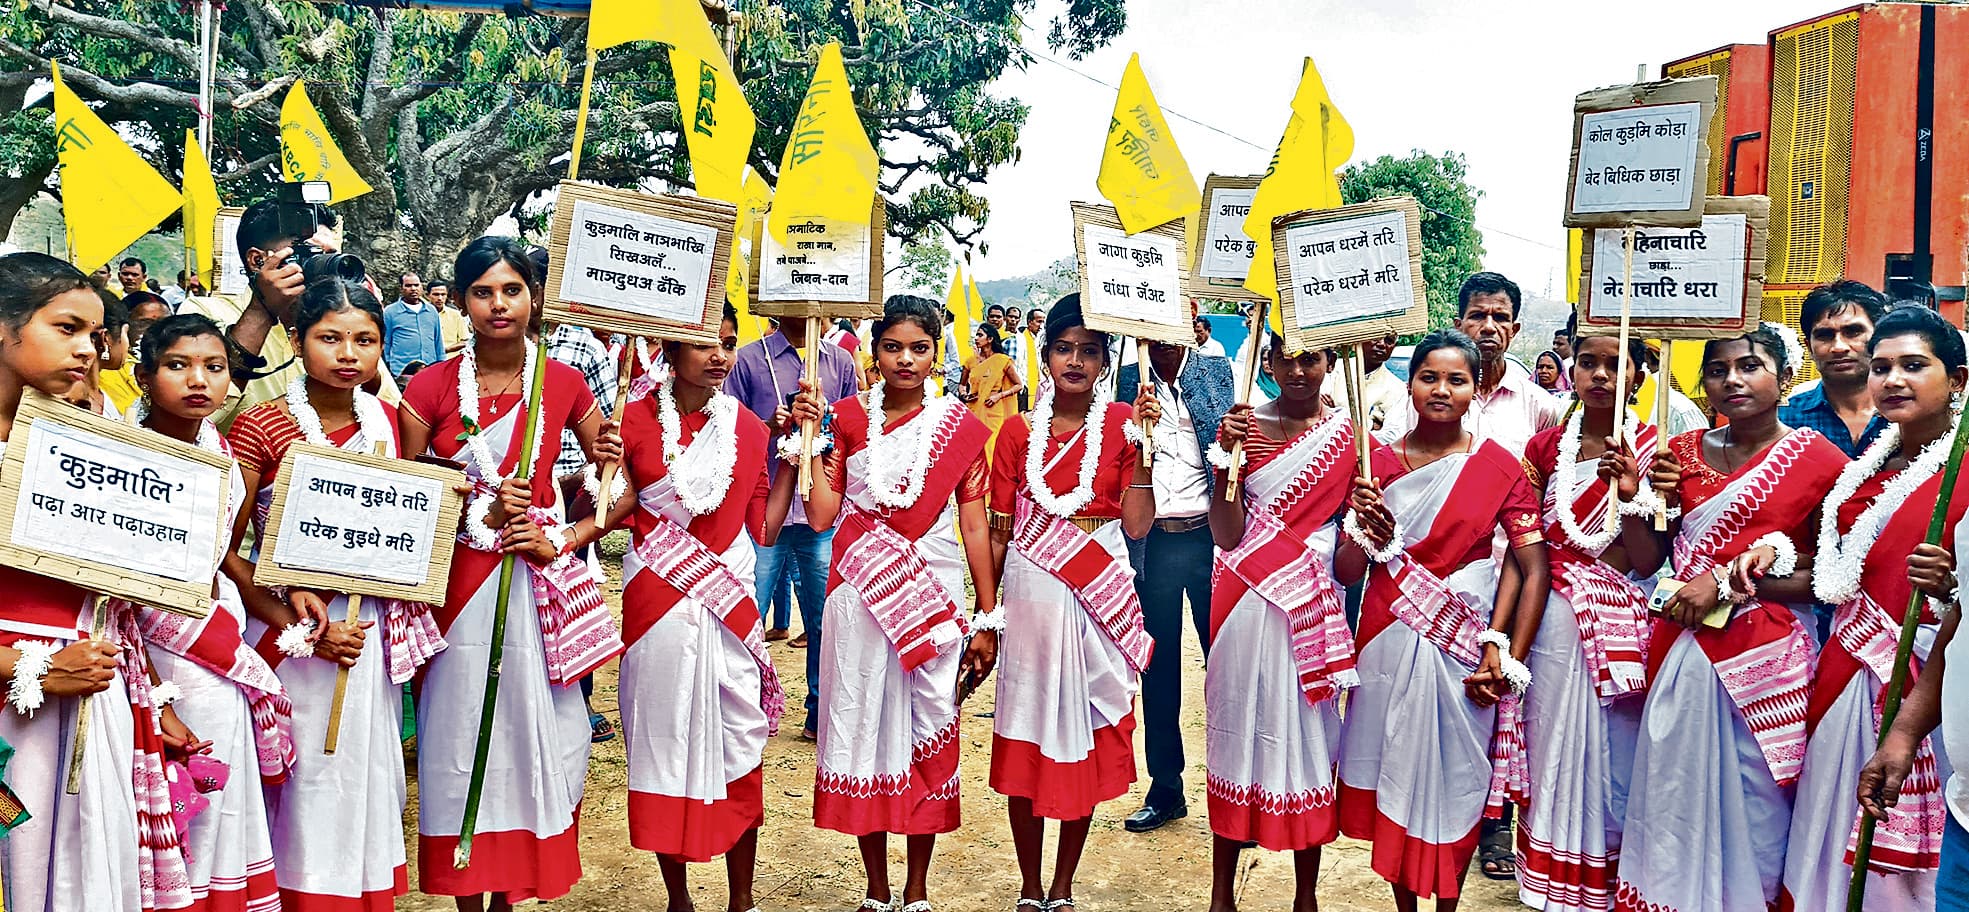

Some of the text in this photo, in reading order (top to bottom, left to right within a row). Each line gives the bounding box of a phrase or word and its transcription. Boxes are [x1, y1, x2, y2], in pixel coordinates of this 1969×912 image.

[1589, 119, 1687, 145] कोल कुड़मि कोड़ा
[1604, 166, 1645, 185] बिधिक
[1650, 168, 1680, 185] छाड़ा
[585, 220, 640, 241] कुड़मालि
[1215, 234, 1243, 252] परेक
[1300, 227, 1395, 257] आपन धरमें तरि
[1098, 243, 1163, 267] जागा कुड़मि
[1304, 264, 1399, 296] परेक धरमें मरि
[1684, 282, 1717, 297] धरा
[309, 478, 429, 511] आपन बुइधे तरि
[32, 492, 188, 544] पढ़ा आर पढ़ाउहान
[299, 517, 415, 552] परेक बुइधे मरि
